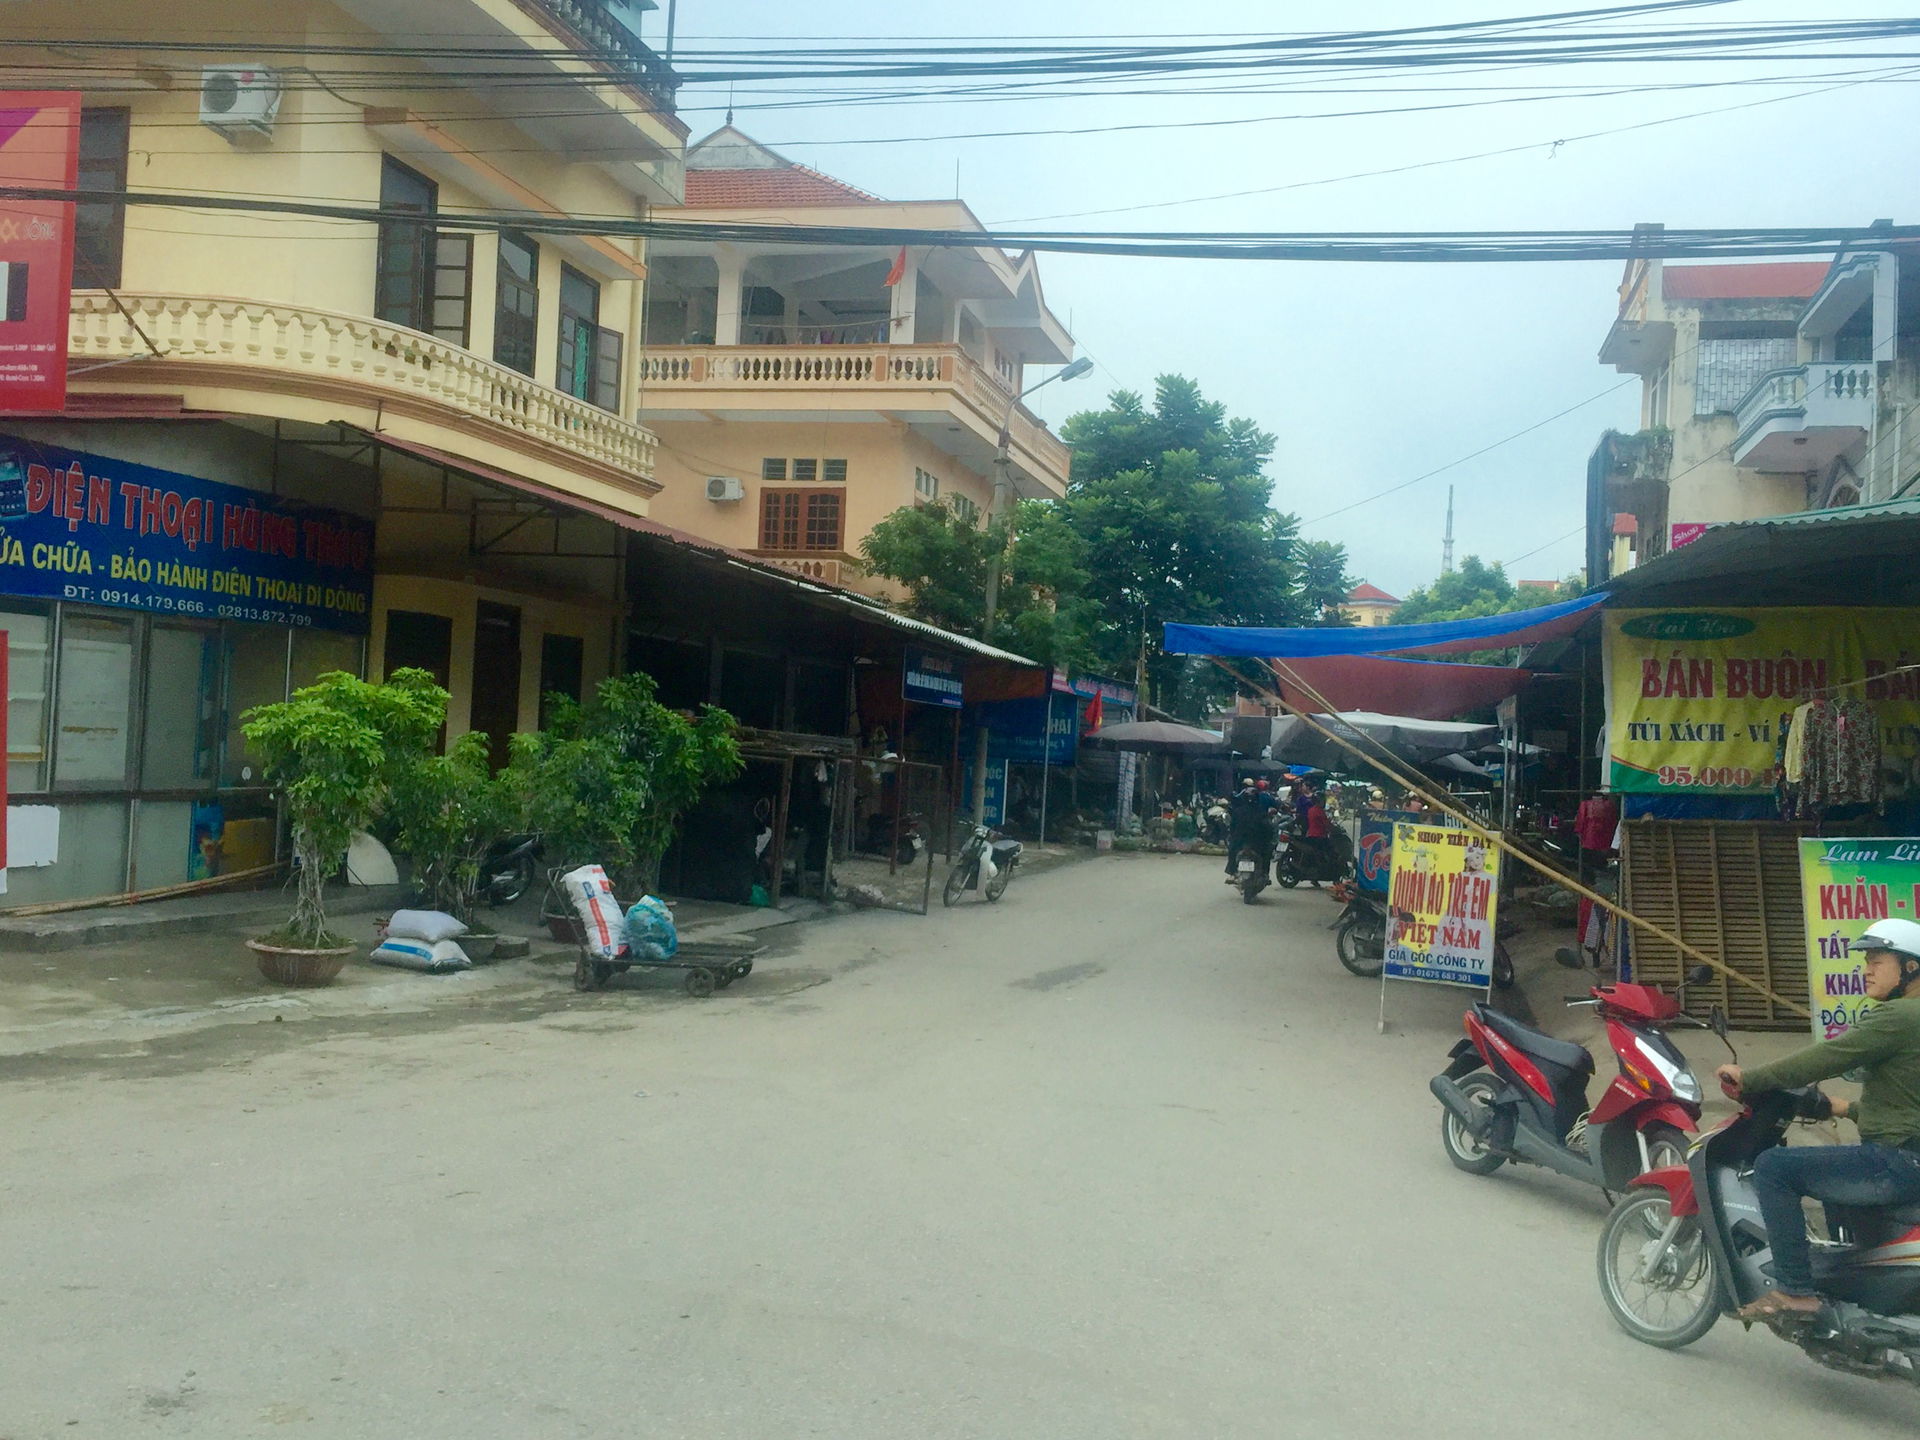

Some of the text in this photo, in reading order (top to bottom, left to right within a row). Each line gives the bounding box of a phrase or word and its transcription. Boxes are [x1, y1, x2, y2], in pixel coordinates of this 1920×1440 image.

[26, 461, 111, 532] ĐIỆN
[120, 481, 214, 552] THOẠI
[1674, 526, 1699, 543] Shop
[32, 540, 93, 575] CHỮA
[111, 546, 151, 584] BẢO
[158, 561, 207, 591] HÀNH
[212, 566, 252, 602] ĐIỆN
[256, 576, 302, 611] THOẠI
[307, 584, 322, 606] DI
[325, 584, 366, 617] ĐỘNG
[63, 585, 95, 601] ĐT:
[101, 589, 204, 614] 0914.179.666
[217, 604, 312, 627] 02813.872.799
[1641, 650, 1714, 698] BÁN
[1726, 648, 1827, 700] BUÔN
[1628, 717, 1662, 742] TÚI
[1669, 718, 1725, 742] XÁCH
[1657, 766, 1753, 787] 95.000
[1417, 831, 1444, 844] SHOP
[1471, 876, 1491, 921] EM
[1819, 876, 1889, 920] KHĂN
[1436, 952, 1467, 968] CÔNG
[1470, 958, 1485, 971] TY
[1818, 930, 1850, 959] TẤT
